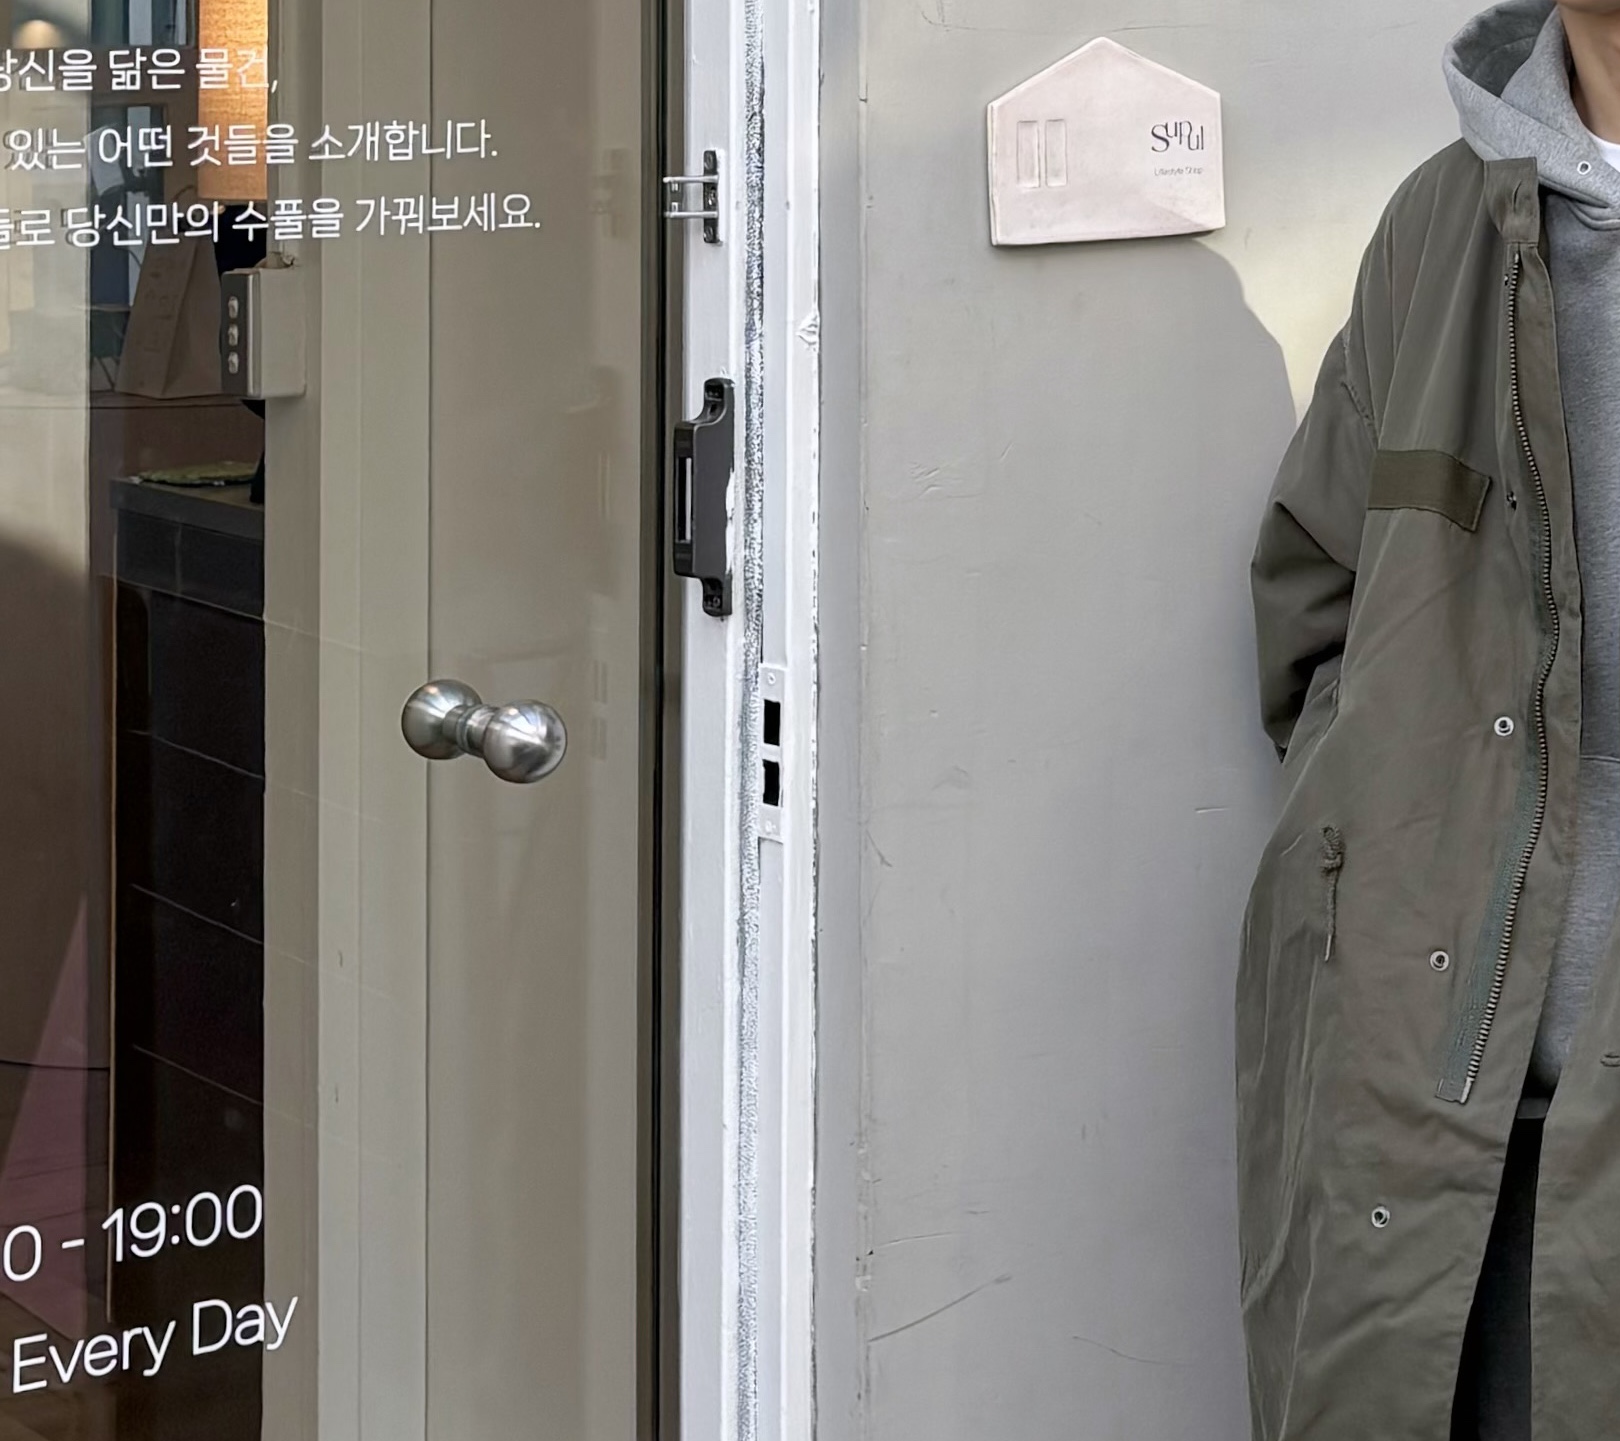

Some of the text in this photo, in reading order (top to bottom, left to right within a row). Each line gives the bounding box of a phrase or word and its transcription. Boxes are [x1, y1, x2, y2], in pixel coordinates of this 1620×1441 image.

[109, 48, 185, 90] 닮은
[195, 48, 278, 93] 물건,
[8, 119, 498, 171] 있는 어떤 것들을 소개합니다.
[66, 200, 219, 248] 당신만의
[232, 197, 344, 242] 수풀을
[355, 192, 541, 237] 가꿔보세요.
[102, 1184, 263, 1262] 19:00
[12, 1296, 299, 1394] Every Day
